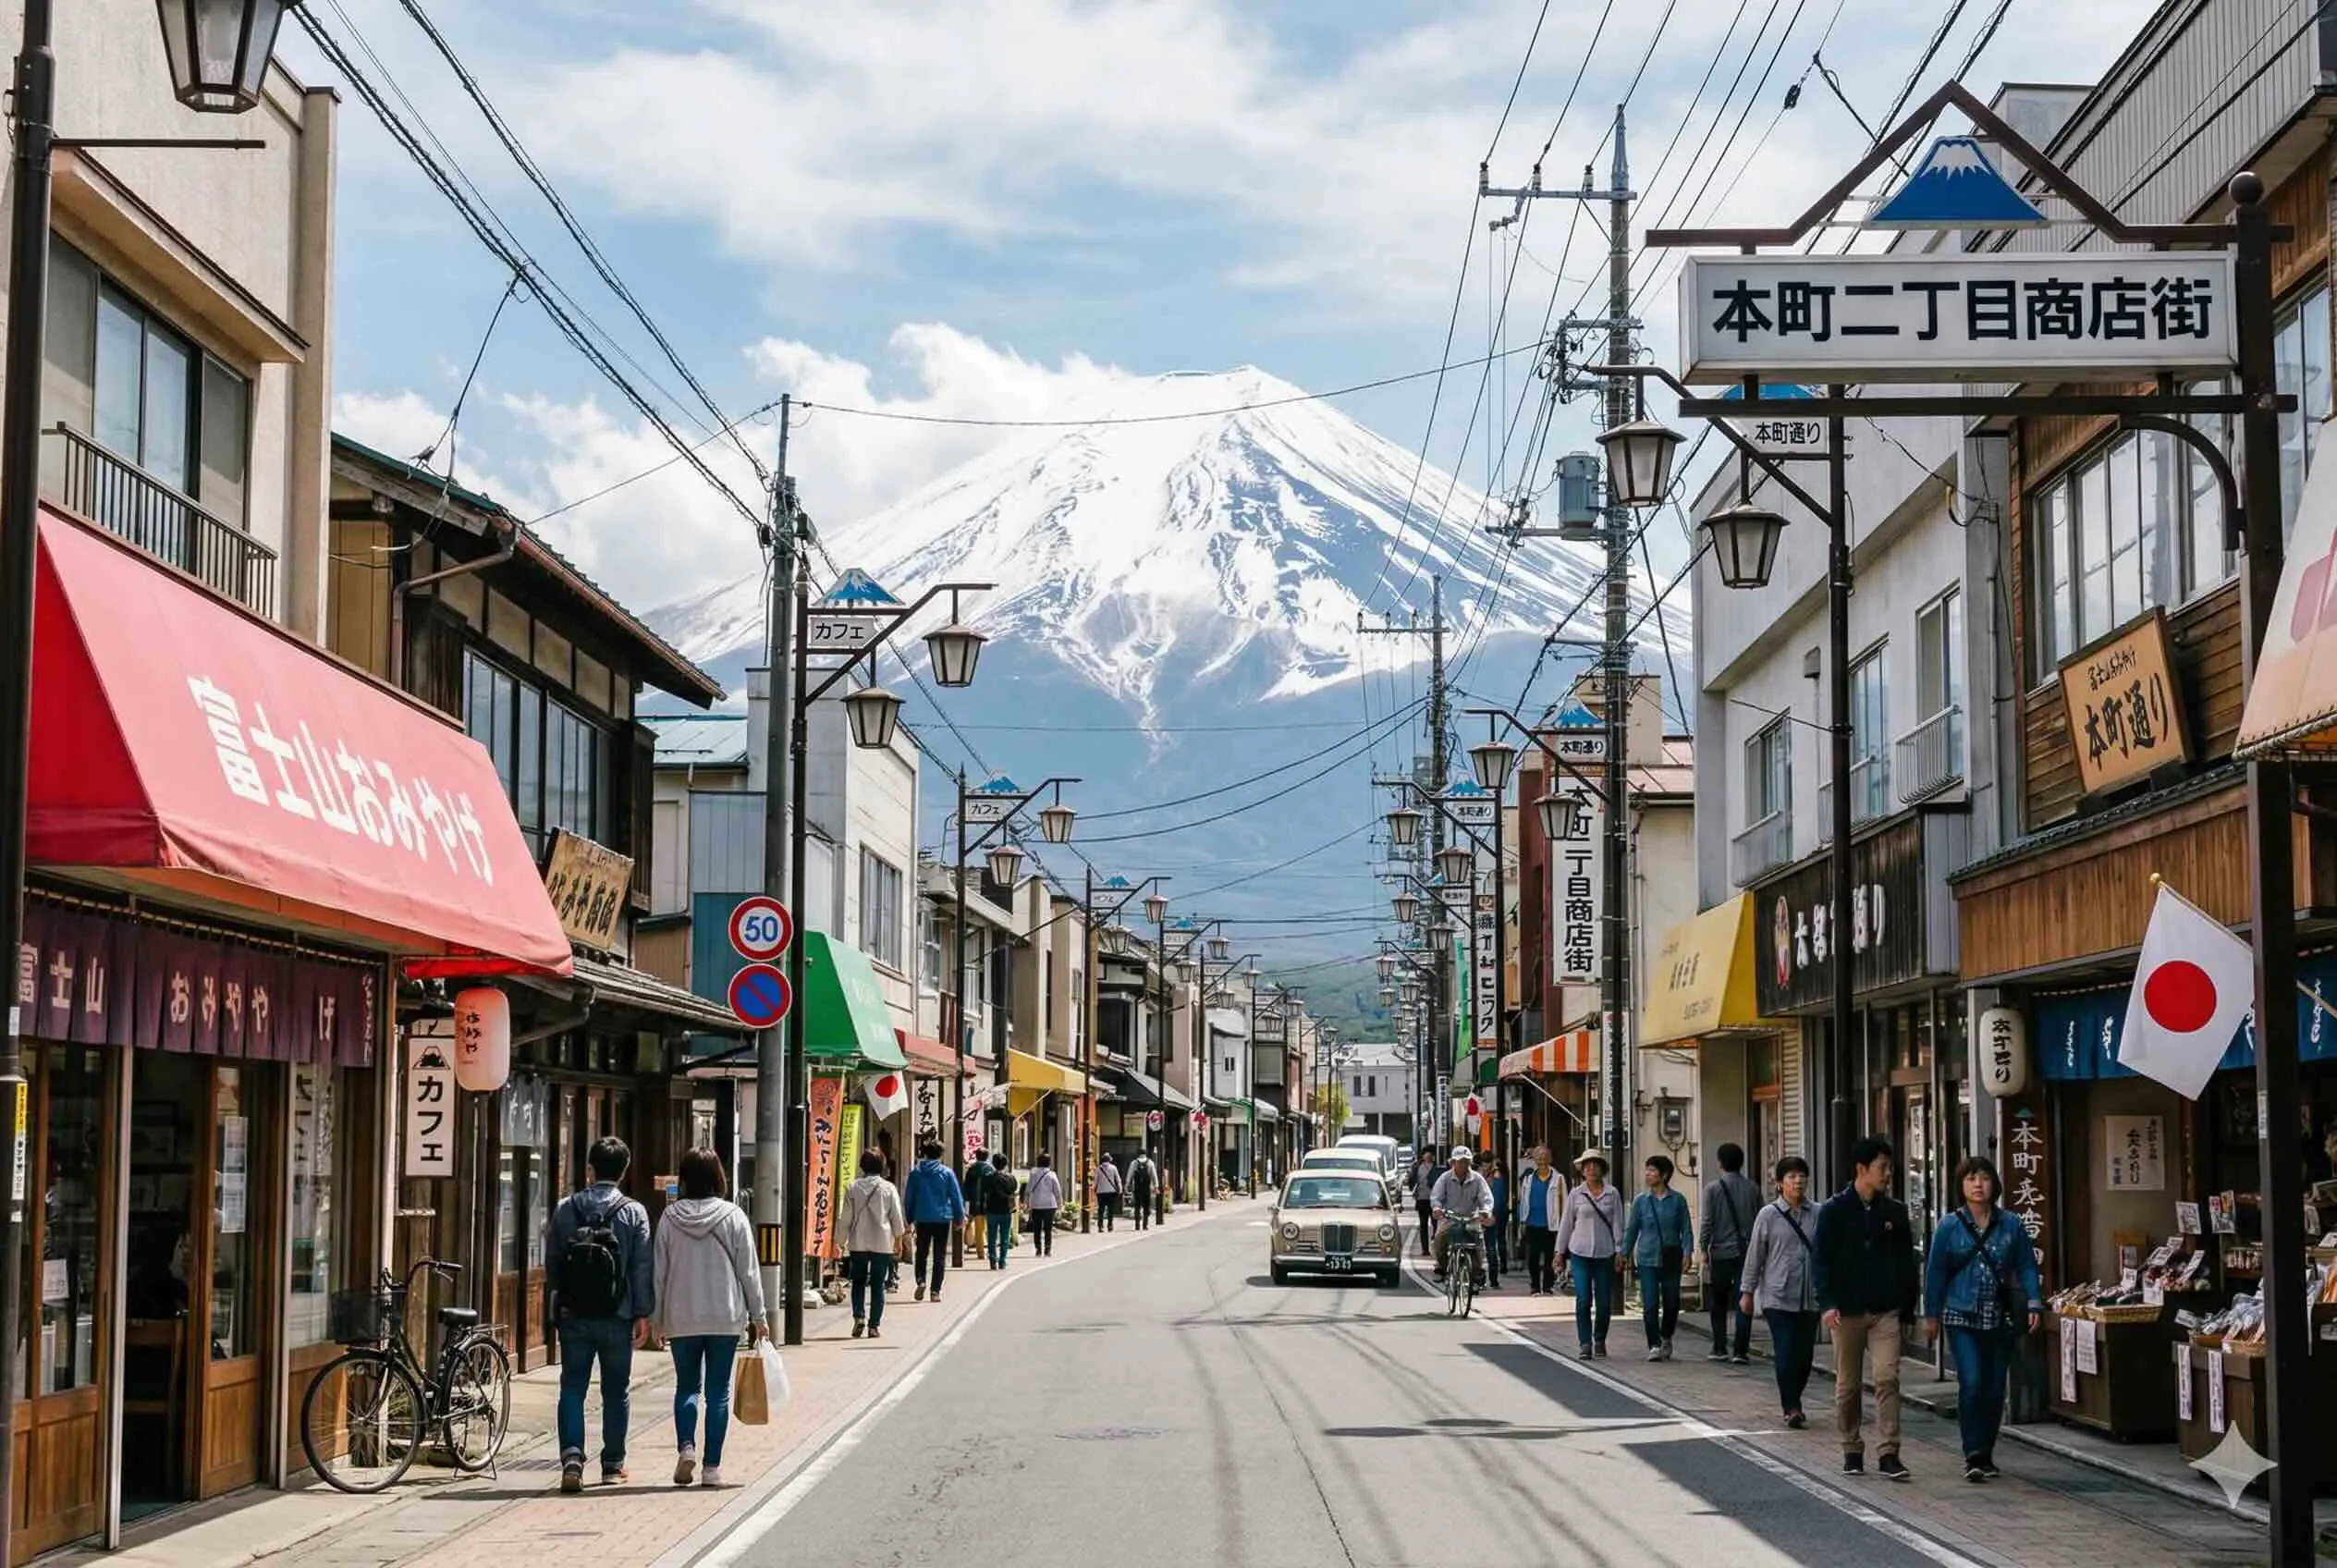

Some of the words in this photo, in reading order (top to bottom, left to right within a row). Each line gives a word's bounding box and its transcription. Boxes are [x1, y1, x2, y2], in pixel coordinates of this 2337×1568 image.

[1712, 276, 2213, 342] 本町二丁目商店街
[1755, 421, 1820, 445] 本町通り
[814, 620, 865, 643] カフェ
[2084, 672, 2169, 771] 本町通り
[187, 674, 494, 887] 富士山おみやげ
[742, 916, 780, 944] 50
[417, 1075, 444, 1162] カフェ
